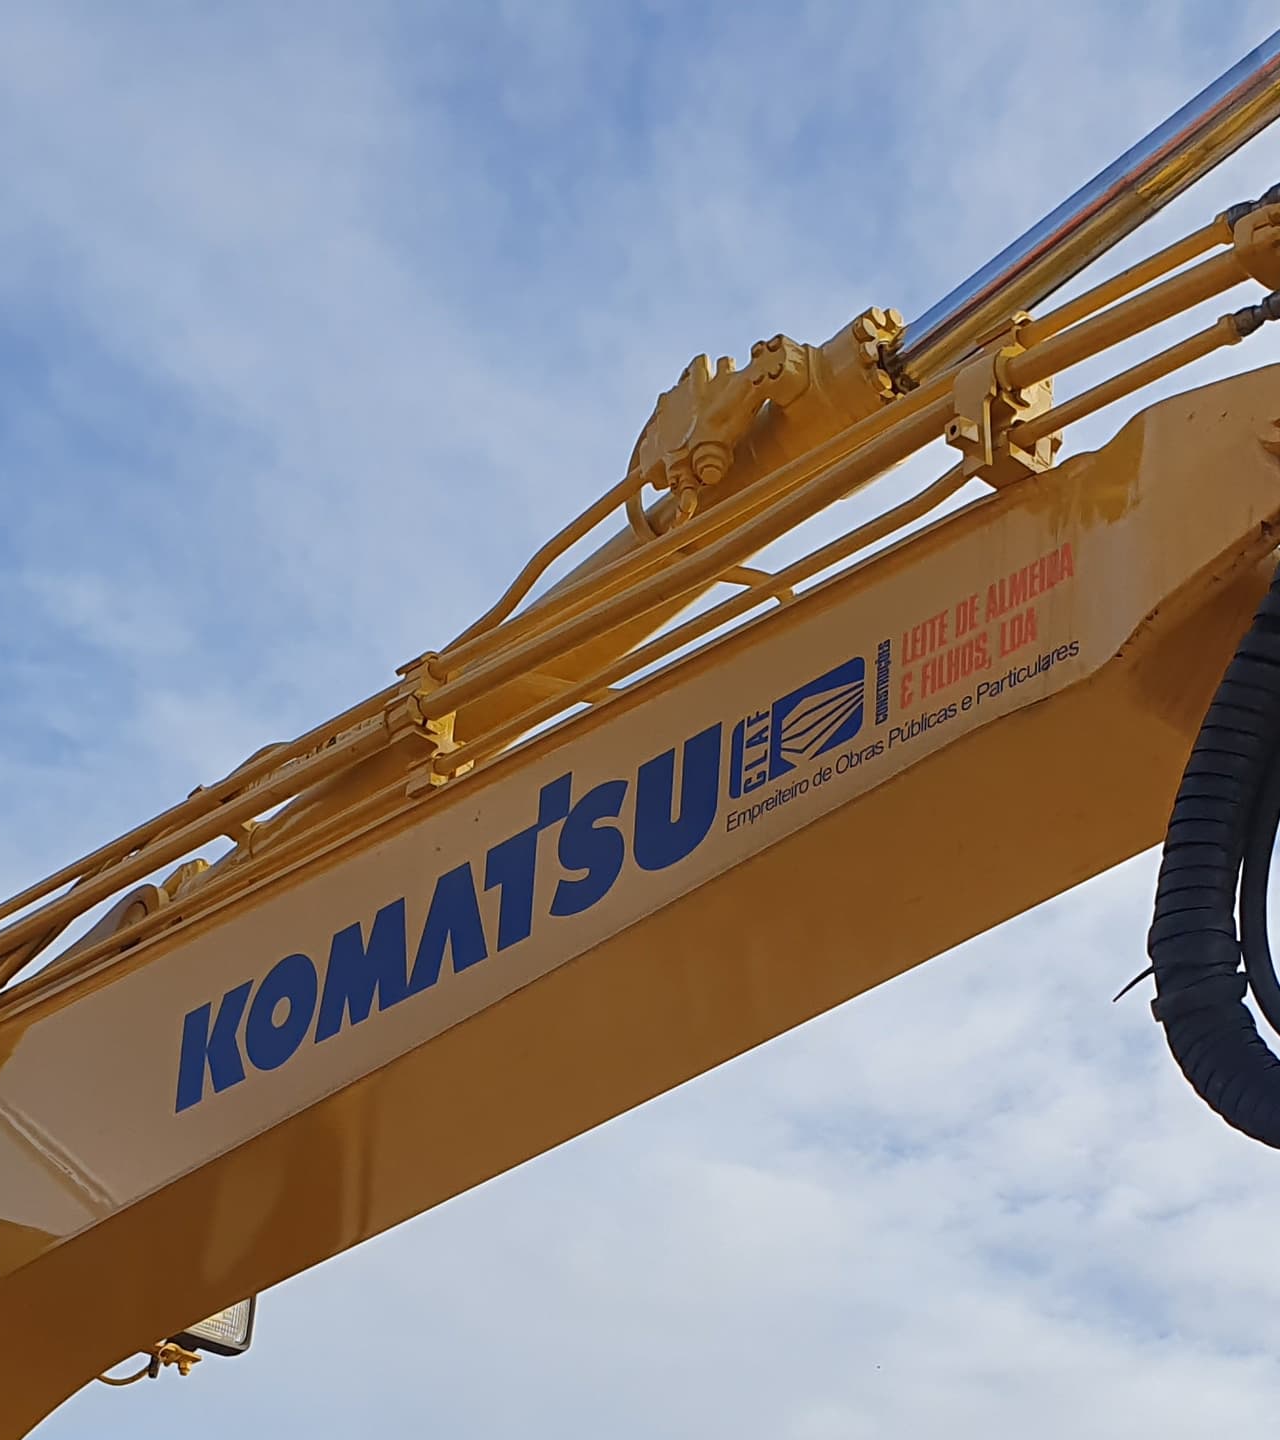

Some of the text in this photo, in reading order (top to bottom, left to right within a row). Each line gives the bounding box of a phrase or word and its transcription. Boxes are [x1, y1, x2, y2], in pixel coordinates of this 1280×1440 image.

[902, 542, 1074, 667] LEITE DE ALMEIDA
[726, 640, 1080, 832] Empreiteiro de Obras Públicas e Particulares
[175, 721, 722, 1113] KOMATSU
